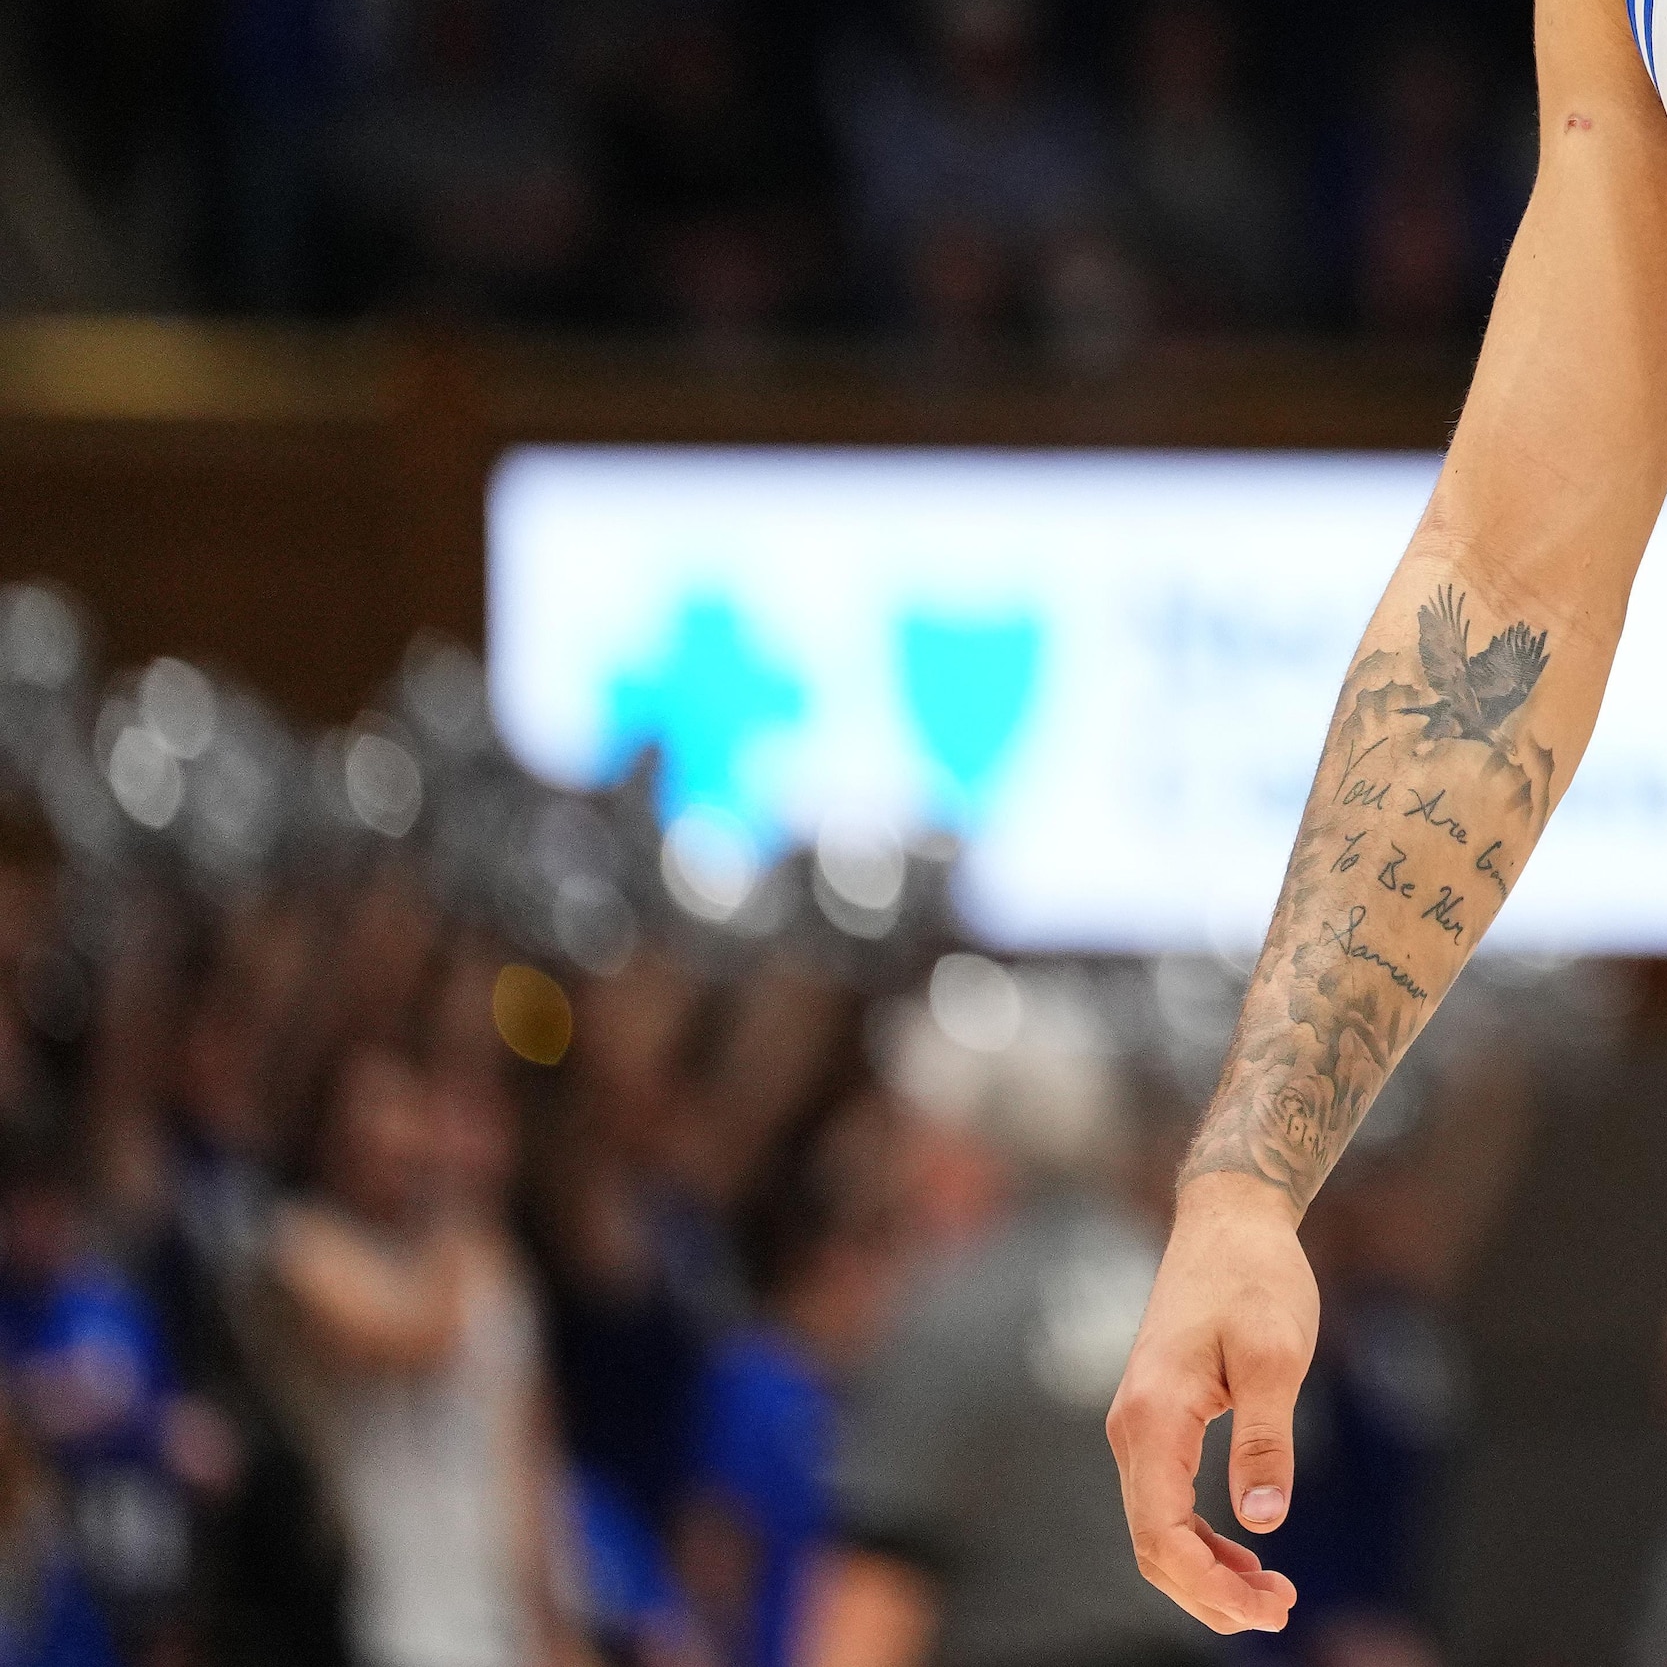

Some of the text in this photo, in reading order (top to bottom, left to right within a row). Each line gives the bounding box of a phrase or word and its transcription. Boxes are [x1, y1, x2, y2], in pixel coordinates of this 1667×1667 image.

[1333, 737, 1392, 811] You
[1403, 788, 1467, 845] Are
[1330, 831, 1367, 874] To
[1378, 841, 1416, 899] Be
